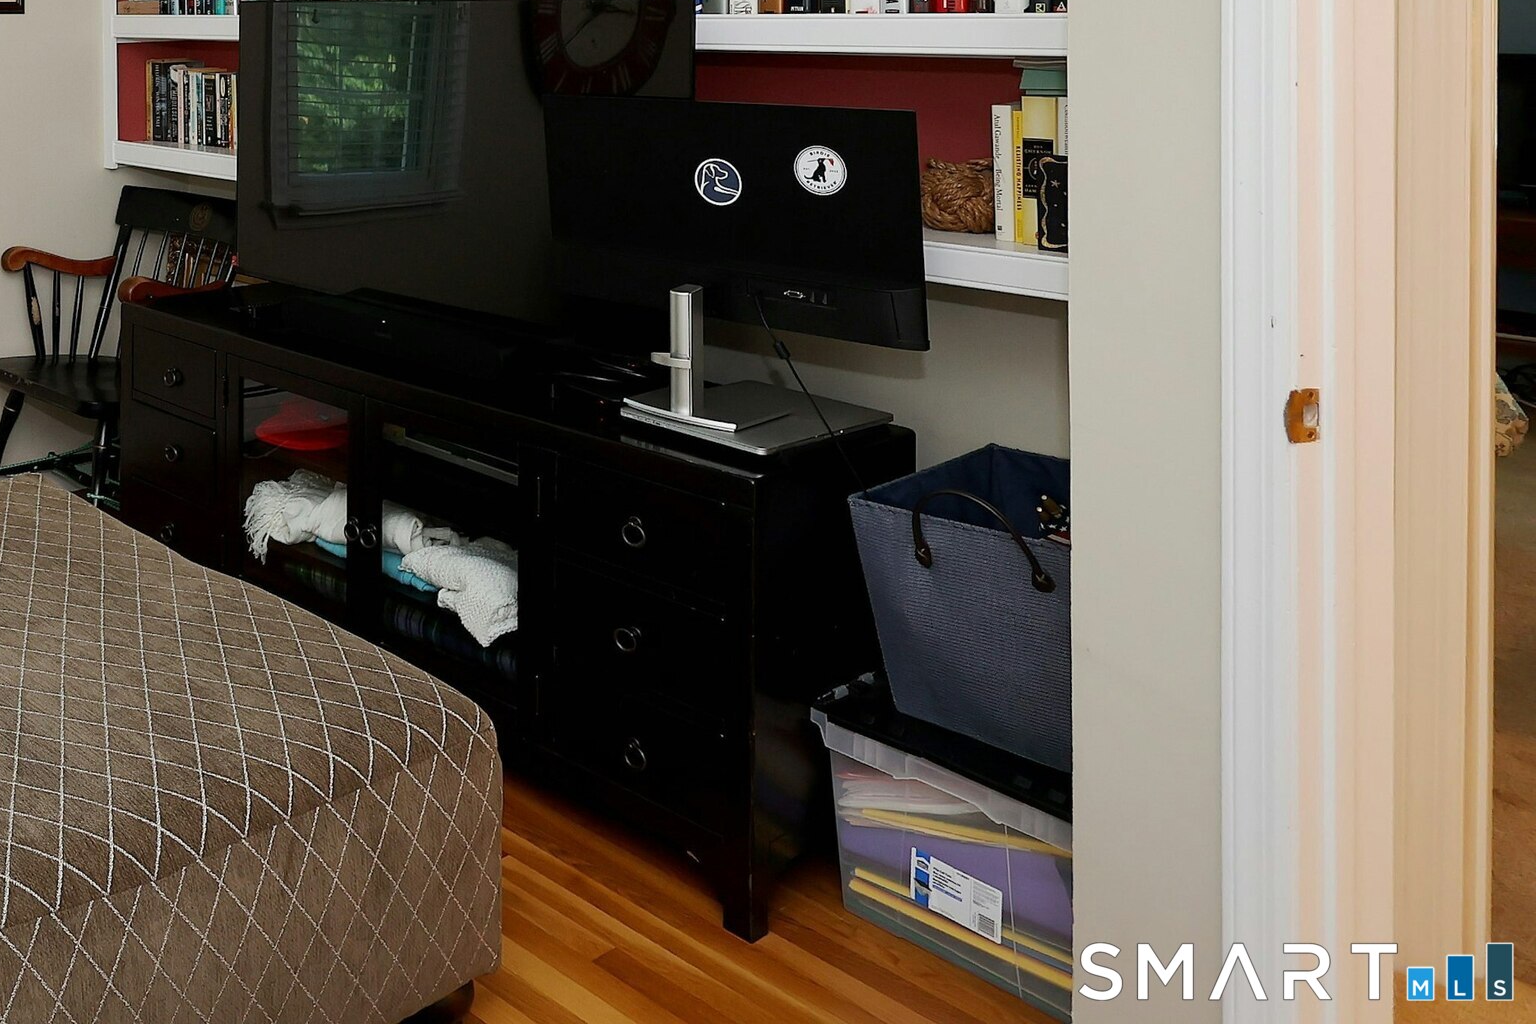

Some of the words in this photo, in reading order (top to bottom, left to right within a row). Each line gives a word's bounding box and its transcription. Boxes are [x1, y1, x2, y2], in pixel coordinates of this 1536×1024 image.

[994, 130, 1003, 159] Gawande
[1015, 146, 1023, 176] RESISTING
[995, 169, 1004, 187] Being
[996, 188, 1004, 211] Mortal
[1015, 177, 1023, 211] HAPPINESS
